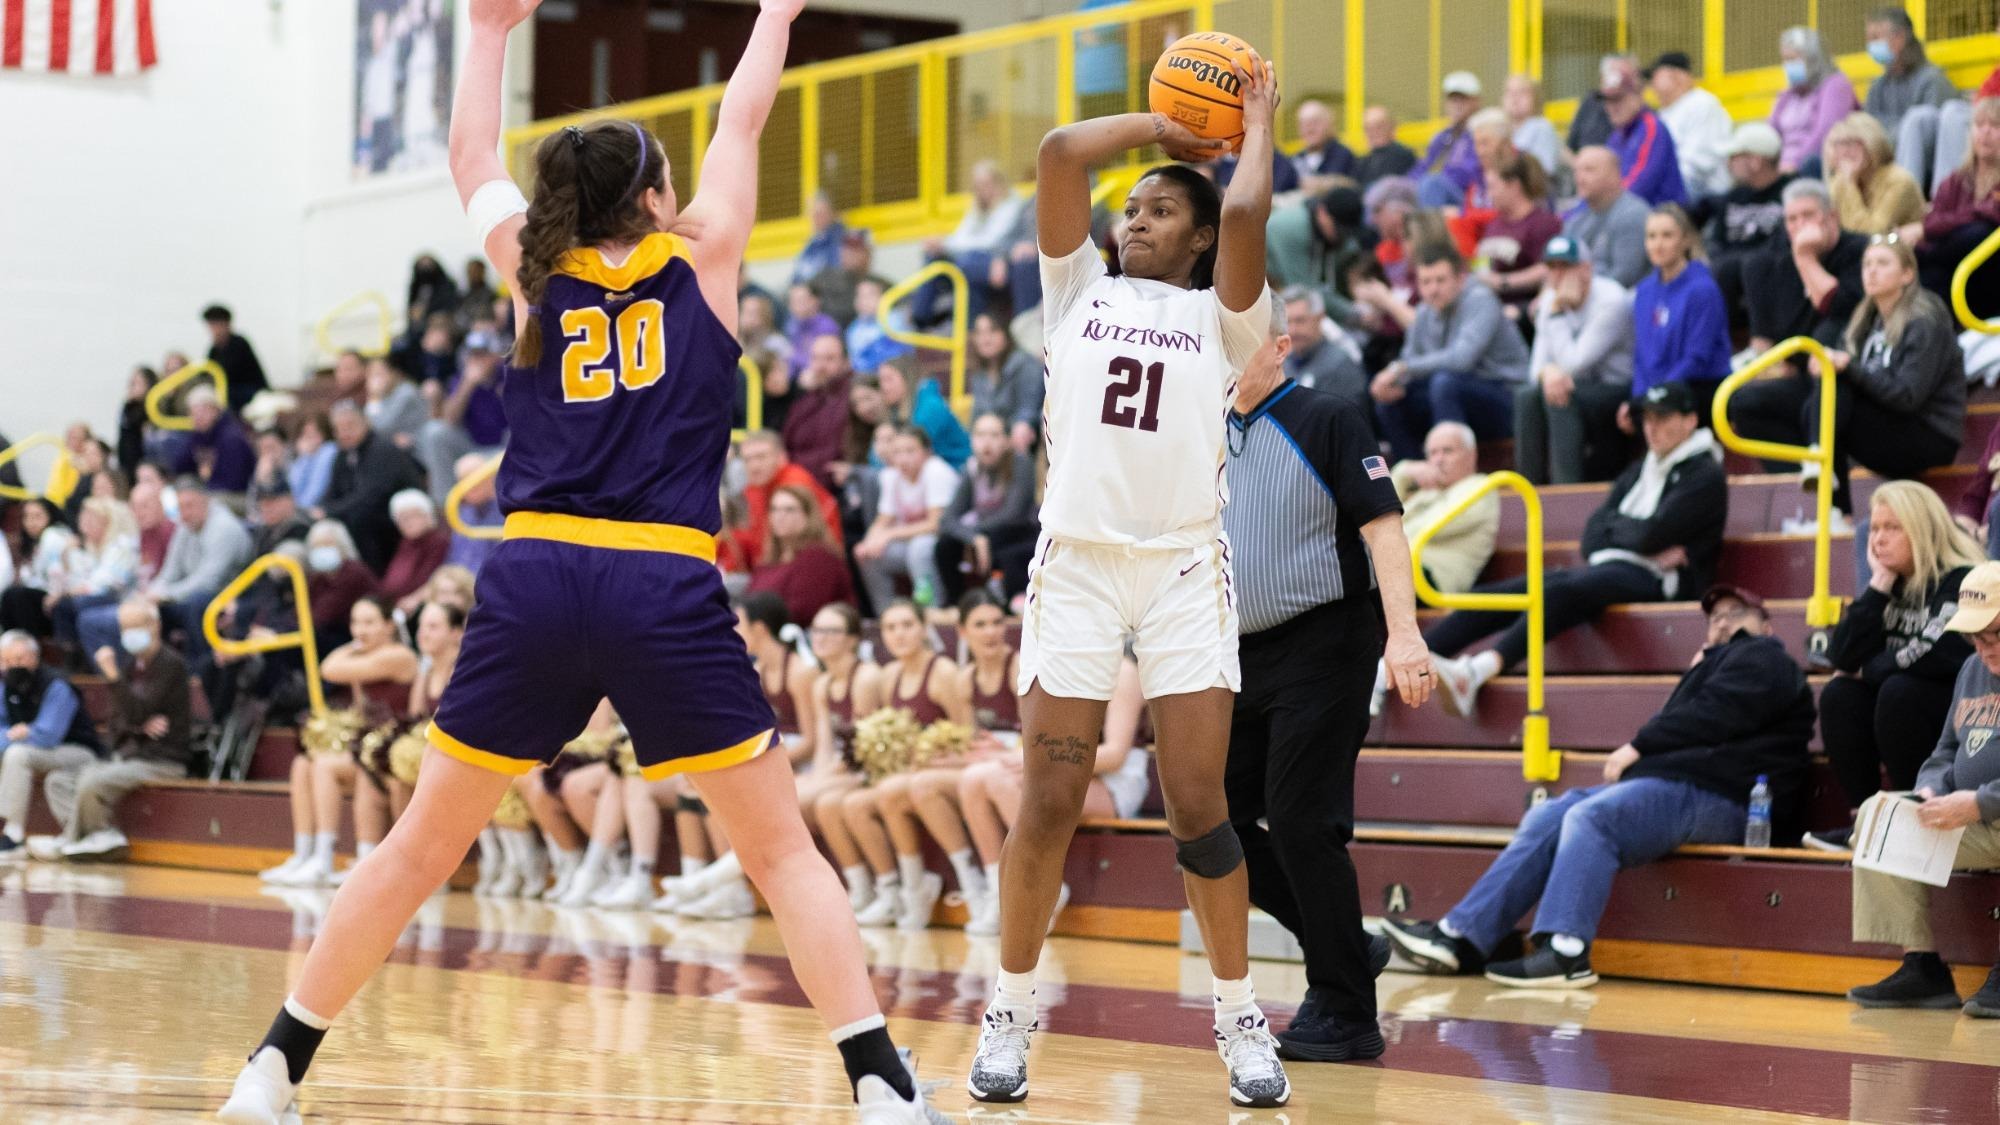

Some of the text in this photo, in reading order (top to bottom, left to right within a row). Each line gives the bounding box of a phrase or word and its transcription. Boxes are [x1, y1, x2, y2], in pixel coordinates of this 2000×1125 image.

[1167, 55, 1242, 98] Wilson
[1171, 107, 1208, 125] PSAC
[560, 298, 665, 403] 20
[1081, 318, 1205, 354] KUTZTOWN
[1101, 356, 1165, 432] 21
[1387, 884, 1406, 912] A
